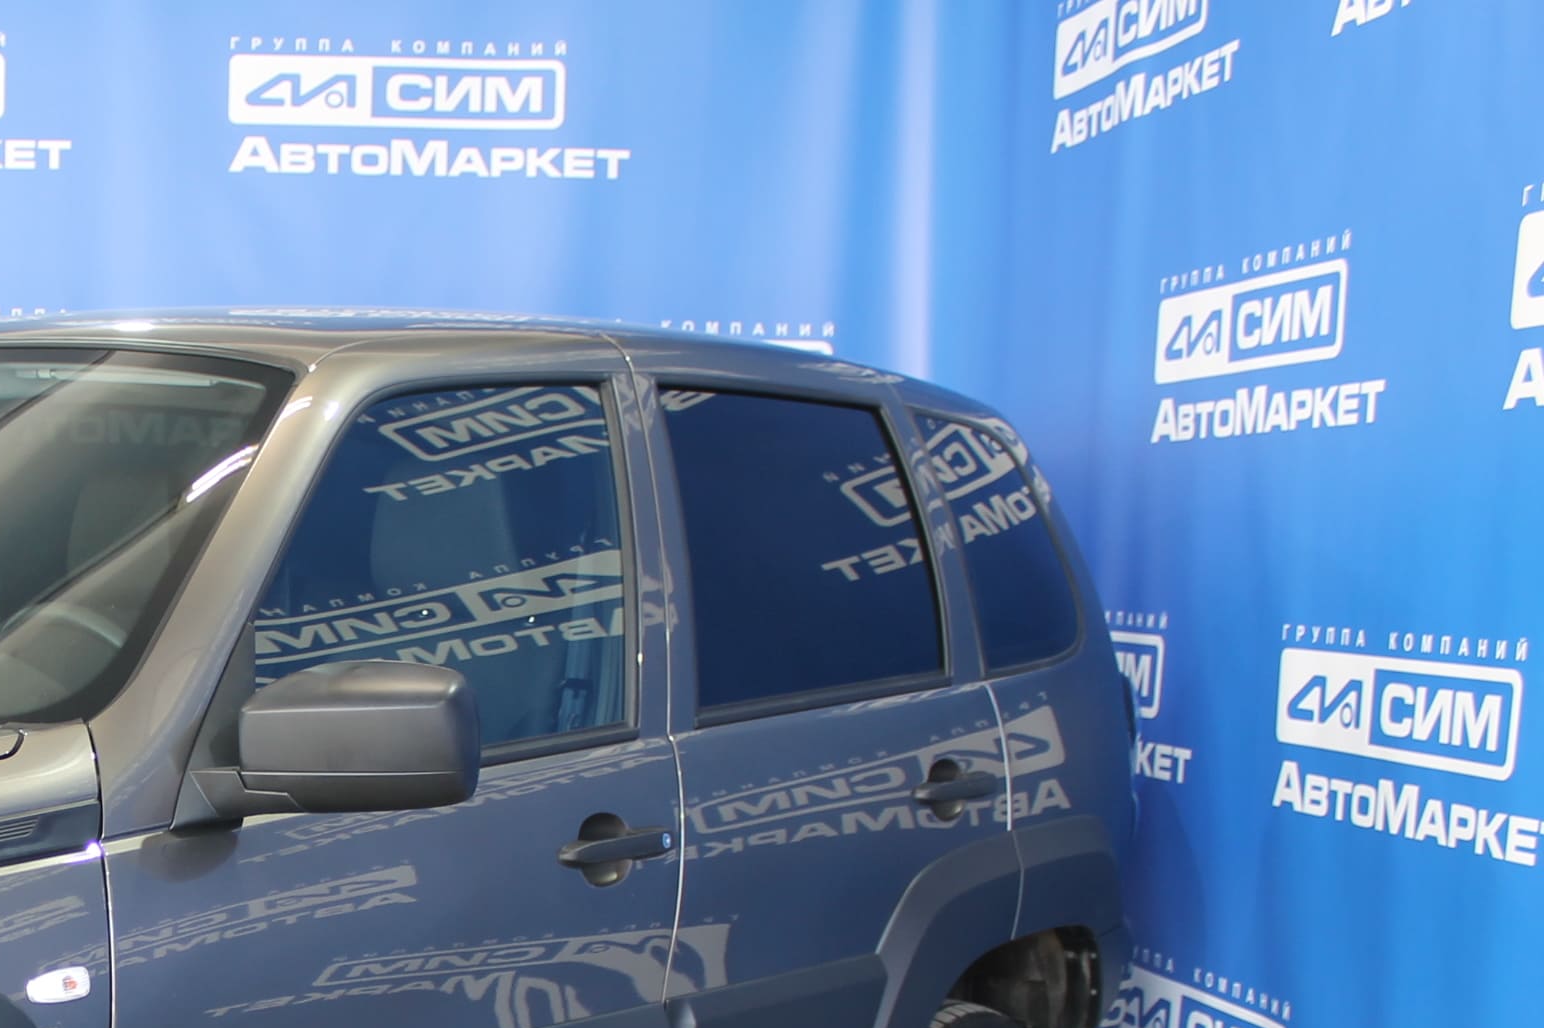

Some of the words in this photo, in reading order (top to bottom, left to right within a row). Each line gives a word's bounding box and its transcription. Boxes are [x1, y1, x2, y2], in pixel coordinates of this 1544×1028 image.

[230, 37, 355, 52] ГРУППА
[391, 40, 567, 56] КОМПАНИЙ
[385, 73, 543, 114] СИМ
[1159, 264, 1225, 294] ГРУППА
[1241, 228, 1352, 274] КОМПАНИЙ
[1235, 284, 1332, 350] СИМ
[1282, 624, 1365, 647] ГРУППА
[1389, 632, 1528, 661] КОМПАНИЙ
[1380, 682, 1502, 752] СИМ
[1193, 968, 1291, 1021] КОМПАНИЙ
